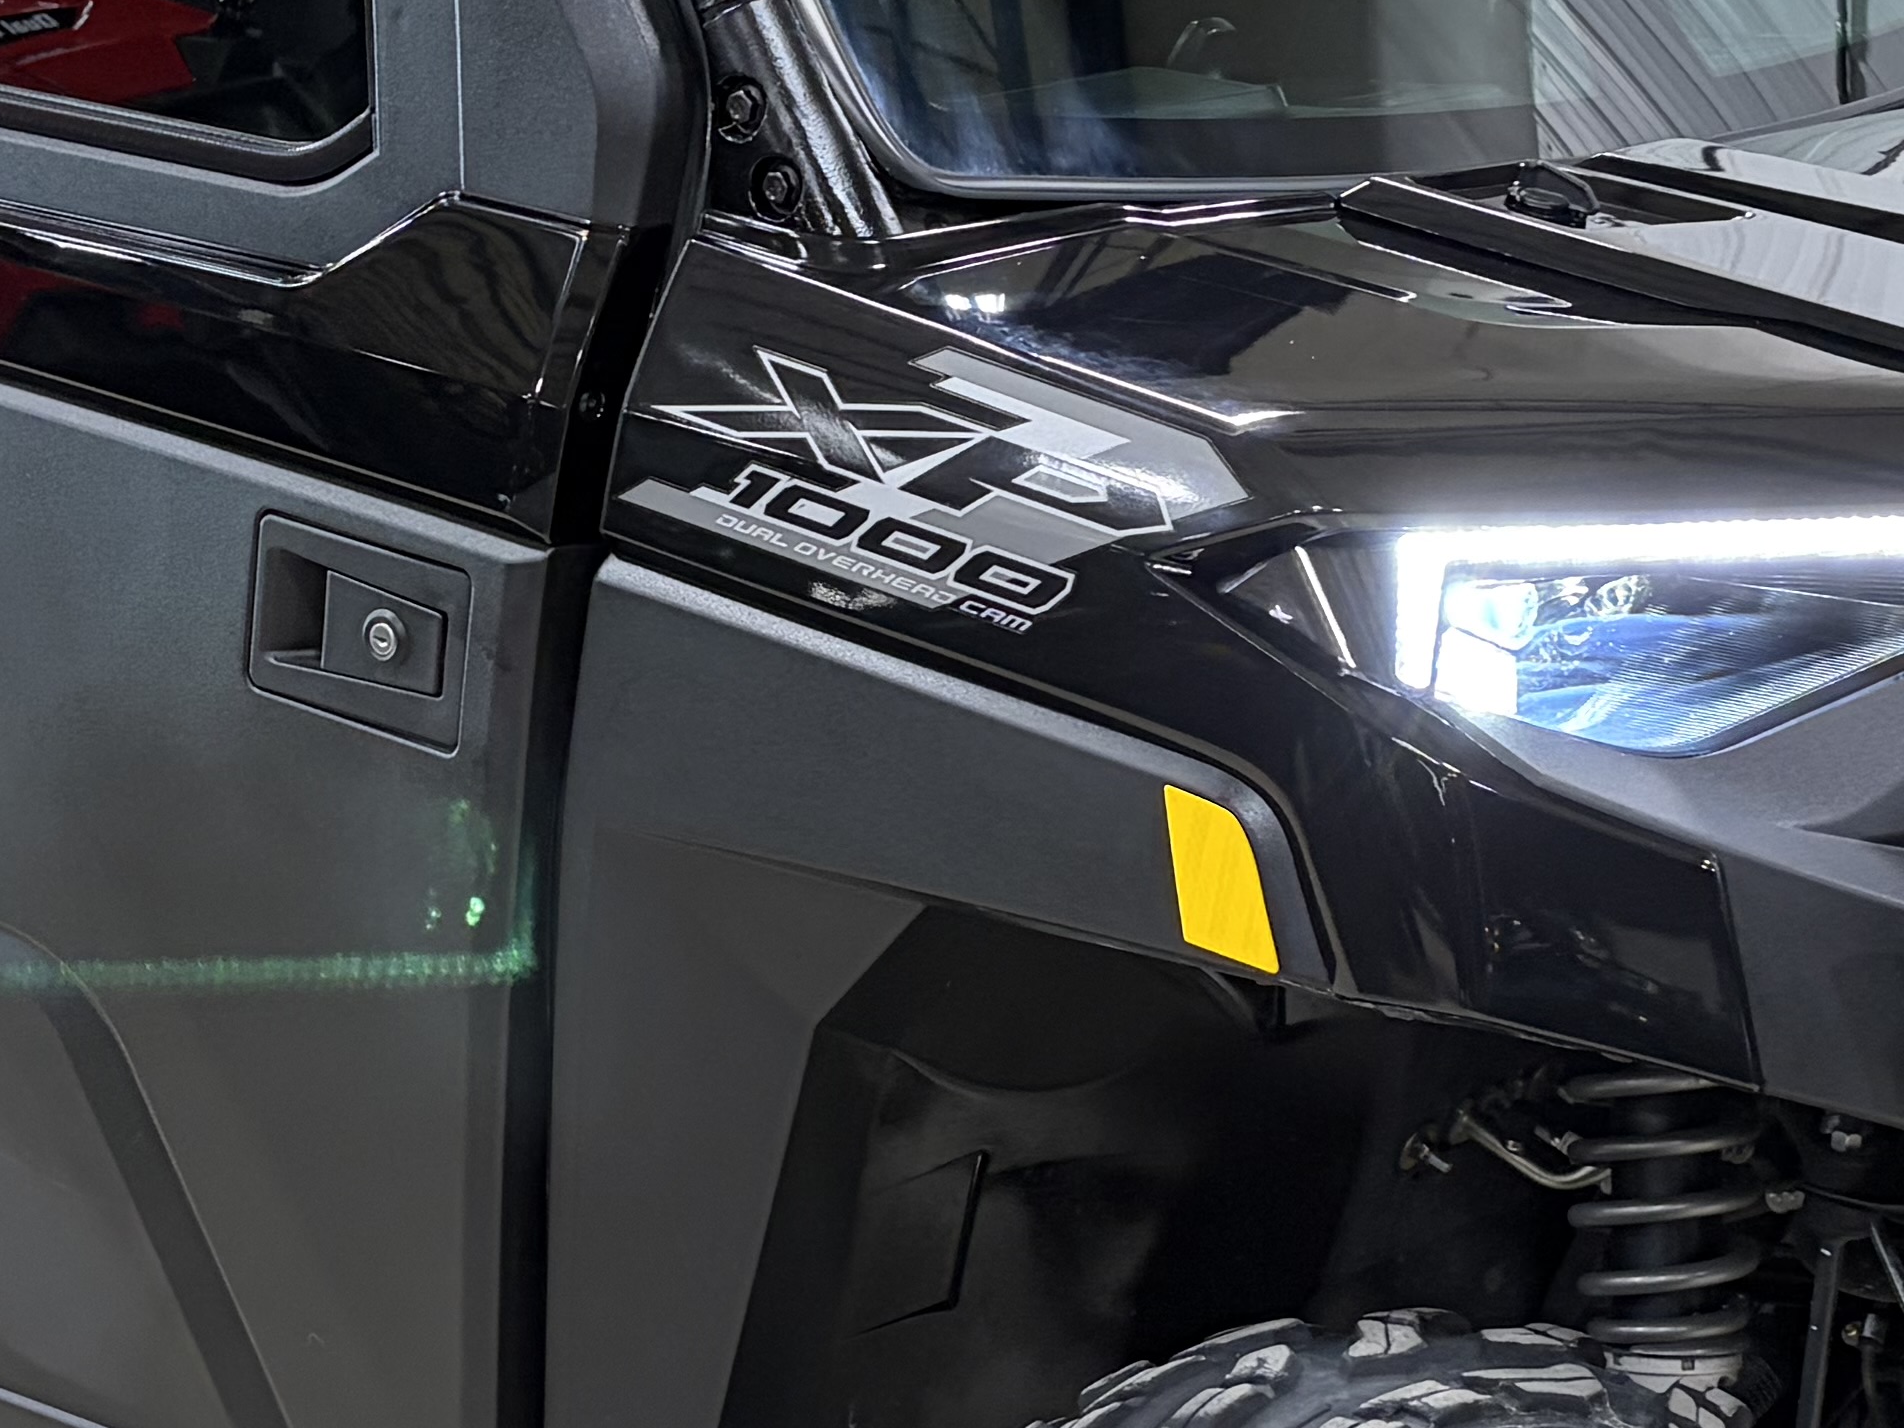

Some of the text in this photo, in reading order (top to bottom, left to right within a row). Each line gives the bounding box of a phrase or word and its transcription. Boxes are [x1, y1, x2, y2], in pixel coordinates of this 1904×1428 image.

[650, 344, 1175, 538] XP
[715, 513, 1033, 633] DUAL OVERHEAD CAM
[726, 462, 1076, 616] 1000
